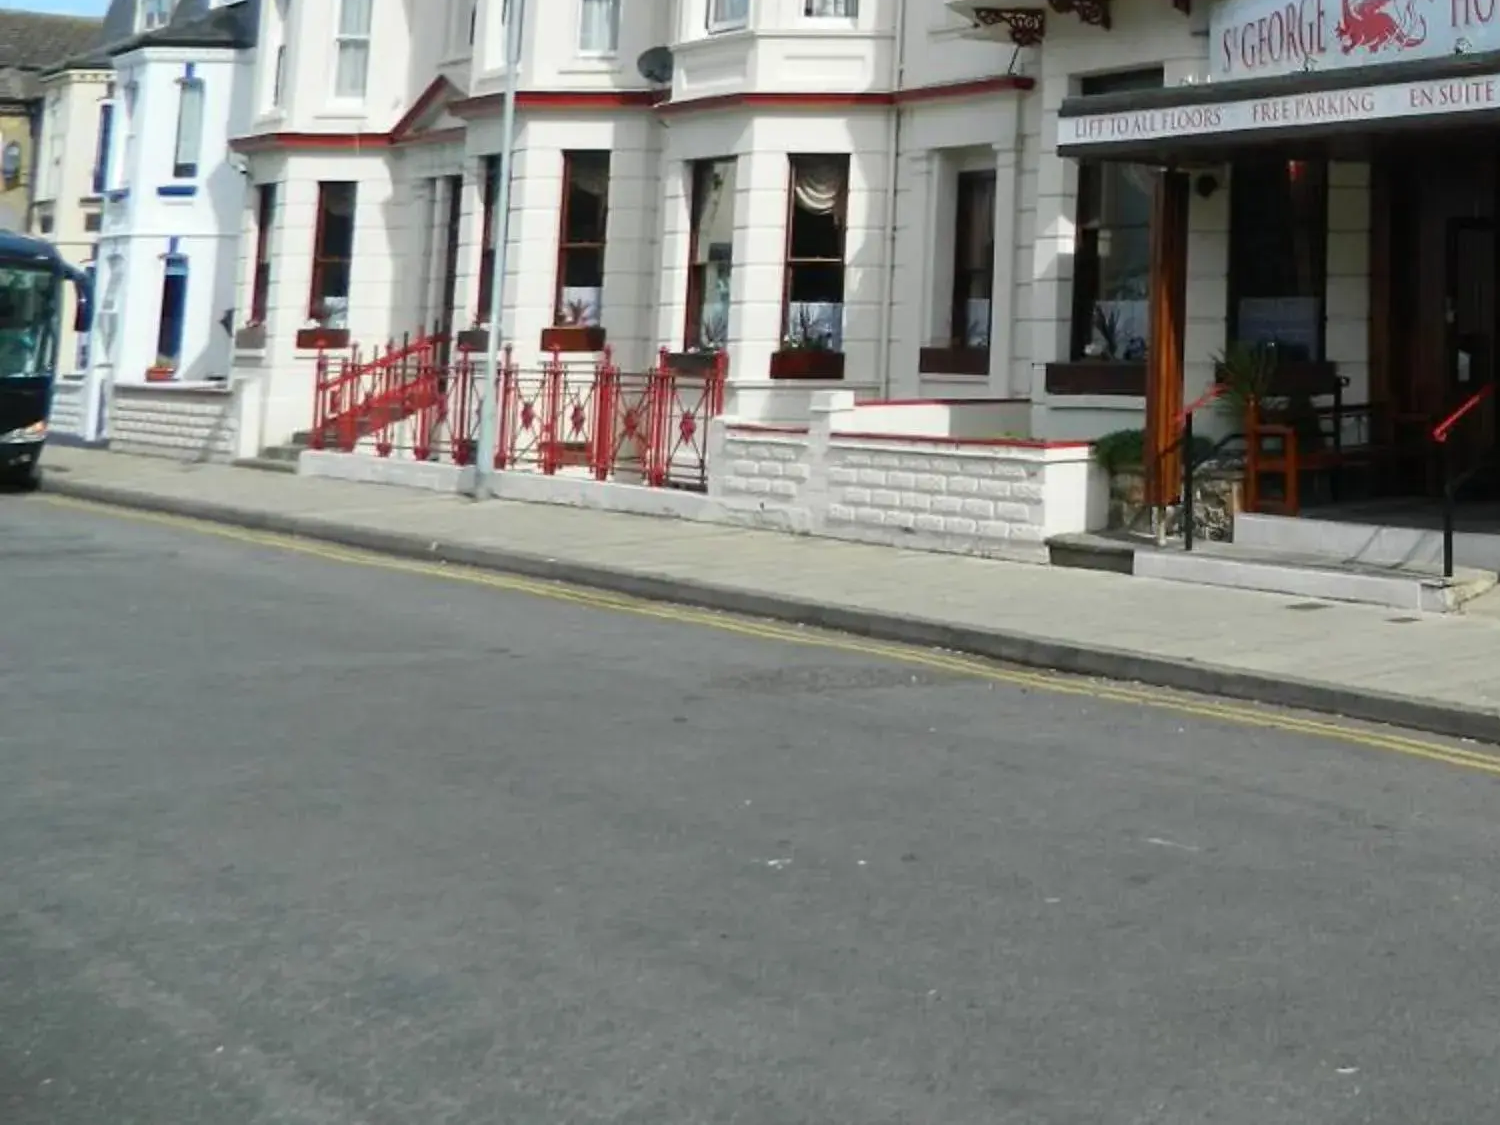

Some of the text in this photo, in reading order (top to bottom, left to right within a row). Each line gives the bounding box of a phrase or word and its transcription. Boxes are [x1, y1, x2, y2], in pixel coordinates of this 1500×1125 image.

[1074, 117, 1104, 139] LIFT
[1109, 115, 1130, 136] TO
[1130, 113, 1156, 134] ALL
[1162, 106, 1223, 131] FLOORS
[1253, 102, 1290, 123] FREE
[1294, 92, 1376, 119] PARKING
[1410, 88, 1434, 107] EN
[1438, 80, 1495, 105] SUITE
